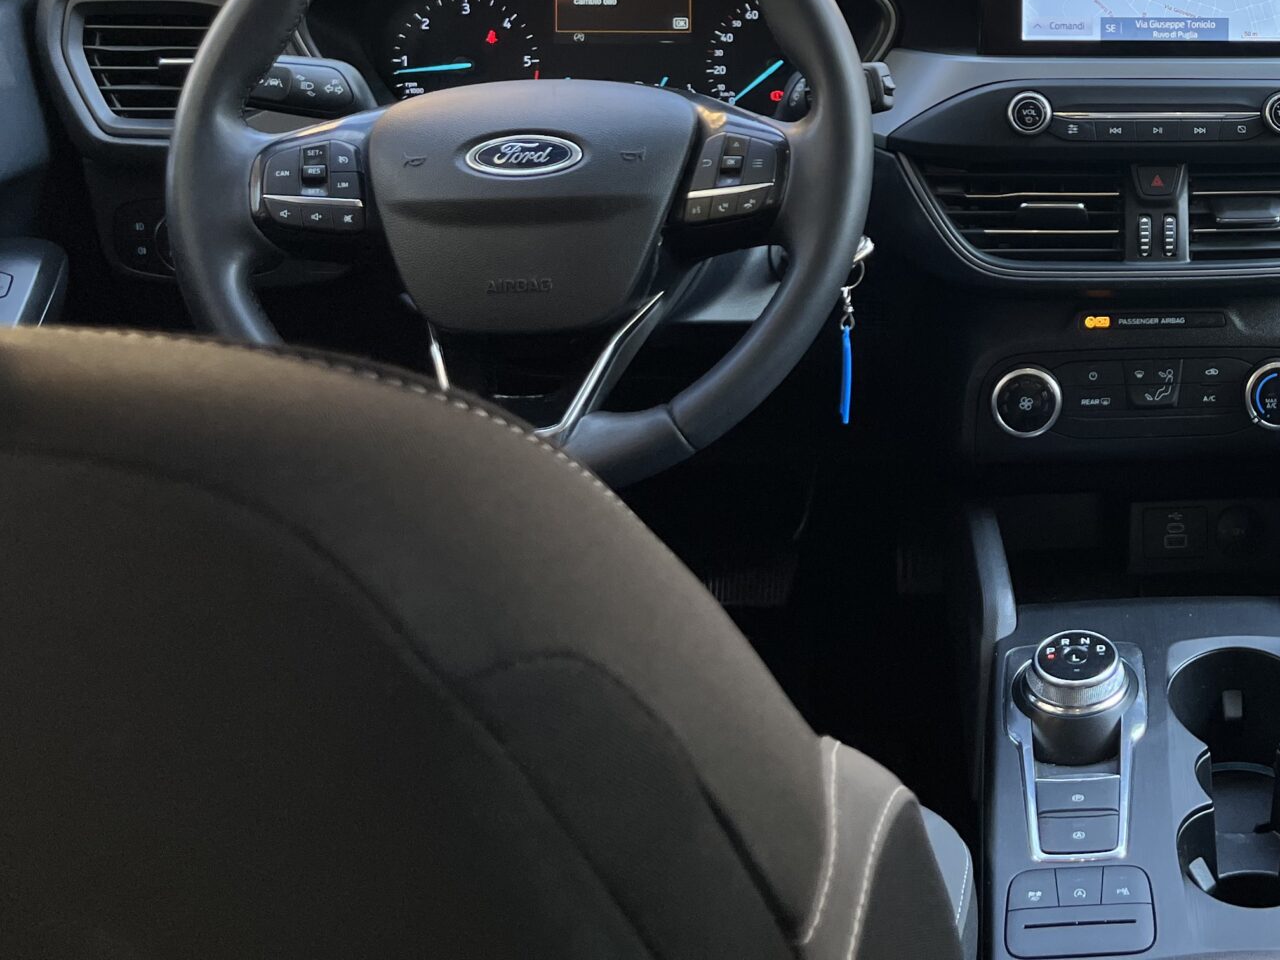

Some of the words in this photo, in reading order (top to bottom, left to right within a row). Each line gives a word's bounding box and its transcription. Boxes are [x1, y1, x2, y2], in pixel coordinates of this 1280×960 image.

[461, 3, 470, 15] 3
[745, 10, 759, 20] 60
[421, 18, 430, 30] 2
[502, 18, 511, 29] 4
[1049, 21, 1085, 30] Comandi
[1105, 24, 1116, 32] SE
[1135, 20, 1148, 29] Via
[1149, 20, 1185, 30] Giuseppe
[1187, 20, 1216, 29] Toniolo
[720, 33, 734, 42] 40
[1152, 31, 1169, 39] Ruvo
[1178, 31, 1198, 40] Puglia
[713, 49, 724, 57] 30
[523, 55, 532, 67] 5
[713, 65, 726, 75] 20
[493, 142, 553, 164] Ford
[1118, 317, 1159, 325] PASSENGER
[1160, 316, 1186, 325] AIRBAG
[1080, 398, 1100, 406] REAR
[1080, 637, 1090, 645] N
[1096, 644, 1106, 652] D
